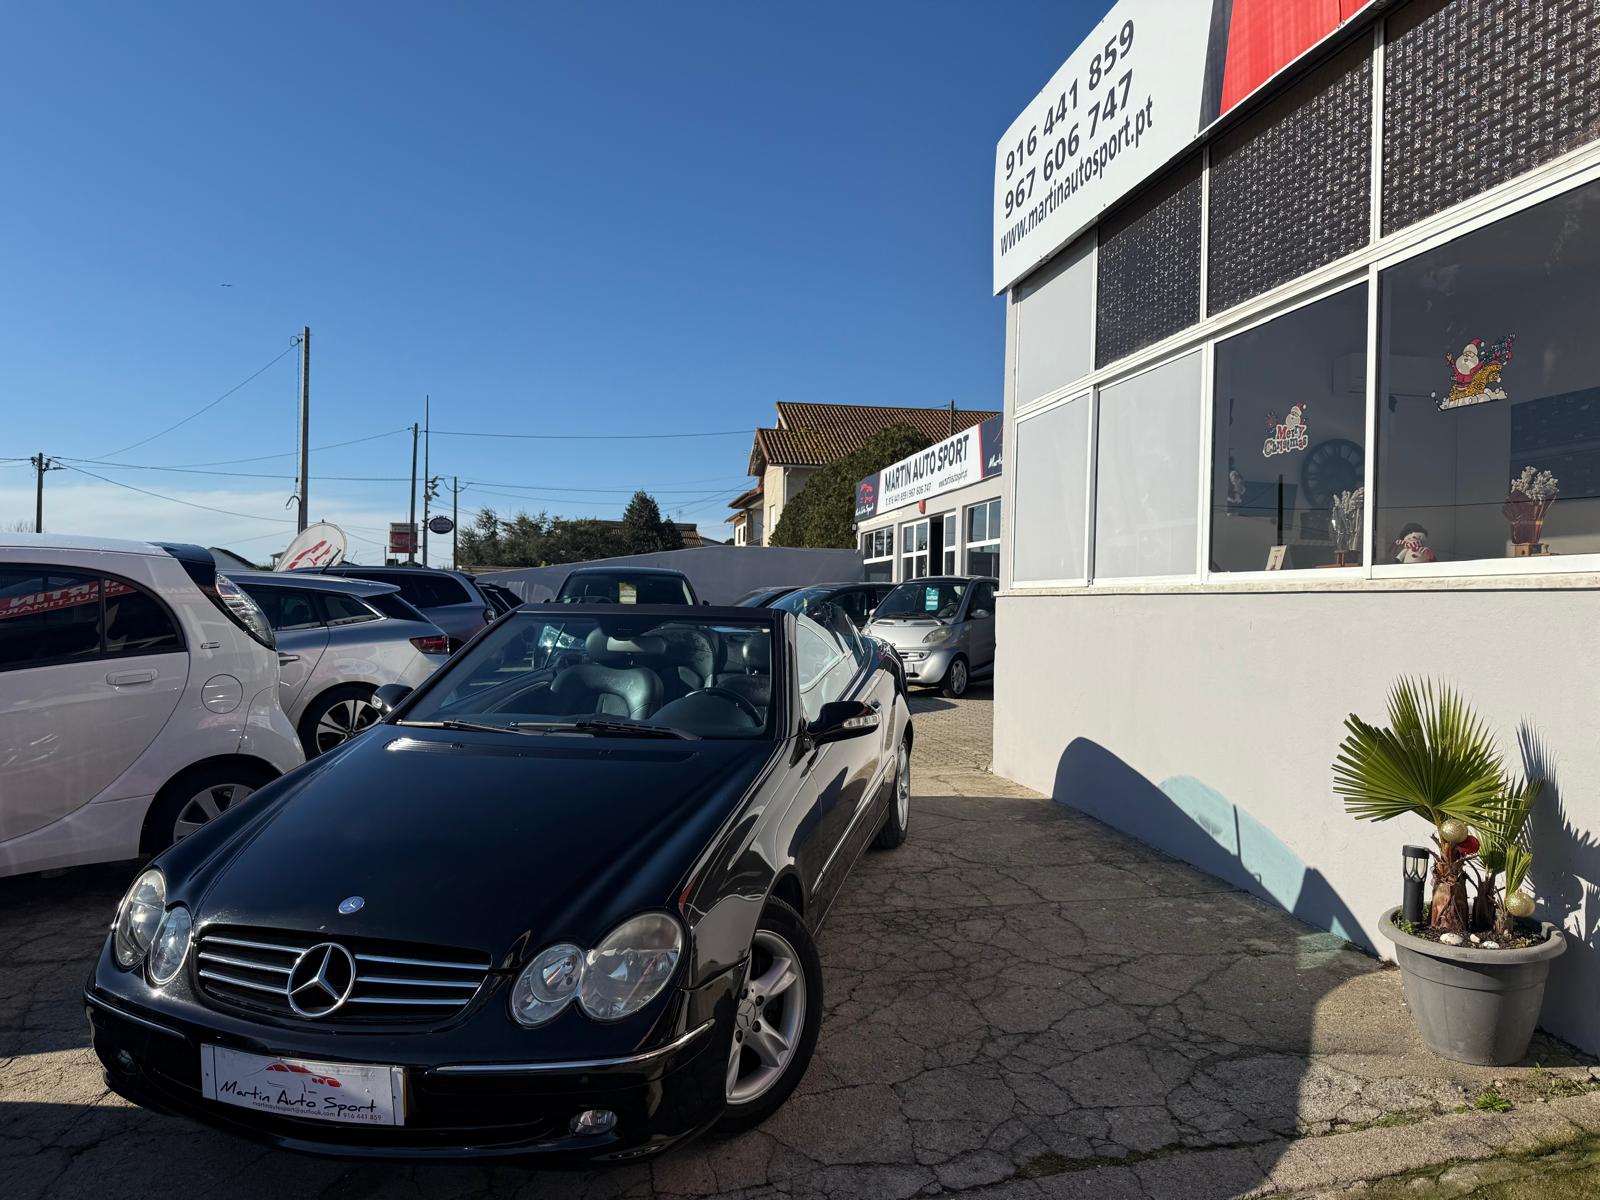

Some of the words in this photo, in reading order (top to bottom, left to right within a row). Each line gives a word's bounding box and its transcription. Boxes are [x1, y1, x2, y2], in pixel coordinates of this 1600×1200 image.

[1005, 124, 1038, 181] 916
[1043, 77, 1078, 137] 441
[1088, 19, 1135, 91] 859
[1004, 166, 1036, 219] 967
[1043, 121, 1080, 182] 606
[1087, 67, 1133, 140] 747
[1000, 93, 1153, 257] www.martinautosport.pt
[1264, 436, 1308, 456] Christmas
[1276, 424, 1306, 441] Merry
[884, 460, 912, 494] MARTIN
[913, 449, 936, 482] AUTO
[937, 434, 970, 472] SPORT
[220, 1080, 270, 1103] Martin
[278, 1090, 316, 1109] Auto
[324, 1098, 376, 1117] Sport
[369, 1113, 382, 1121] 859
